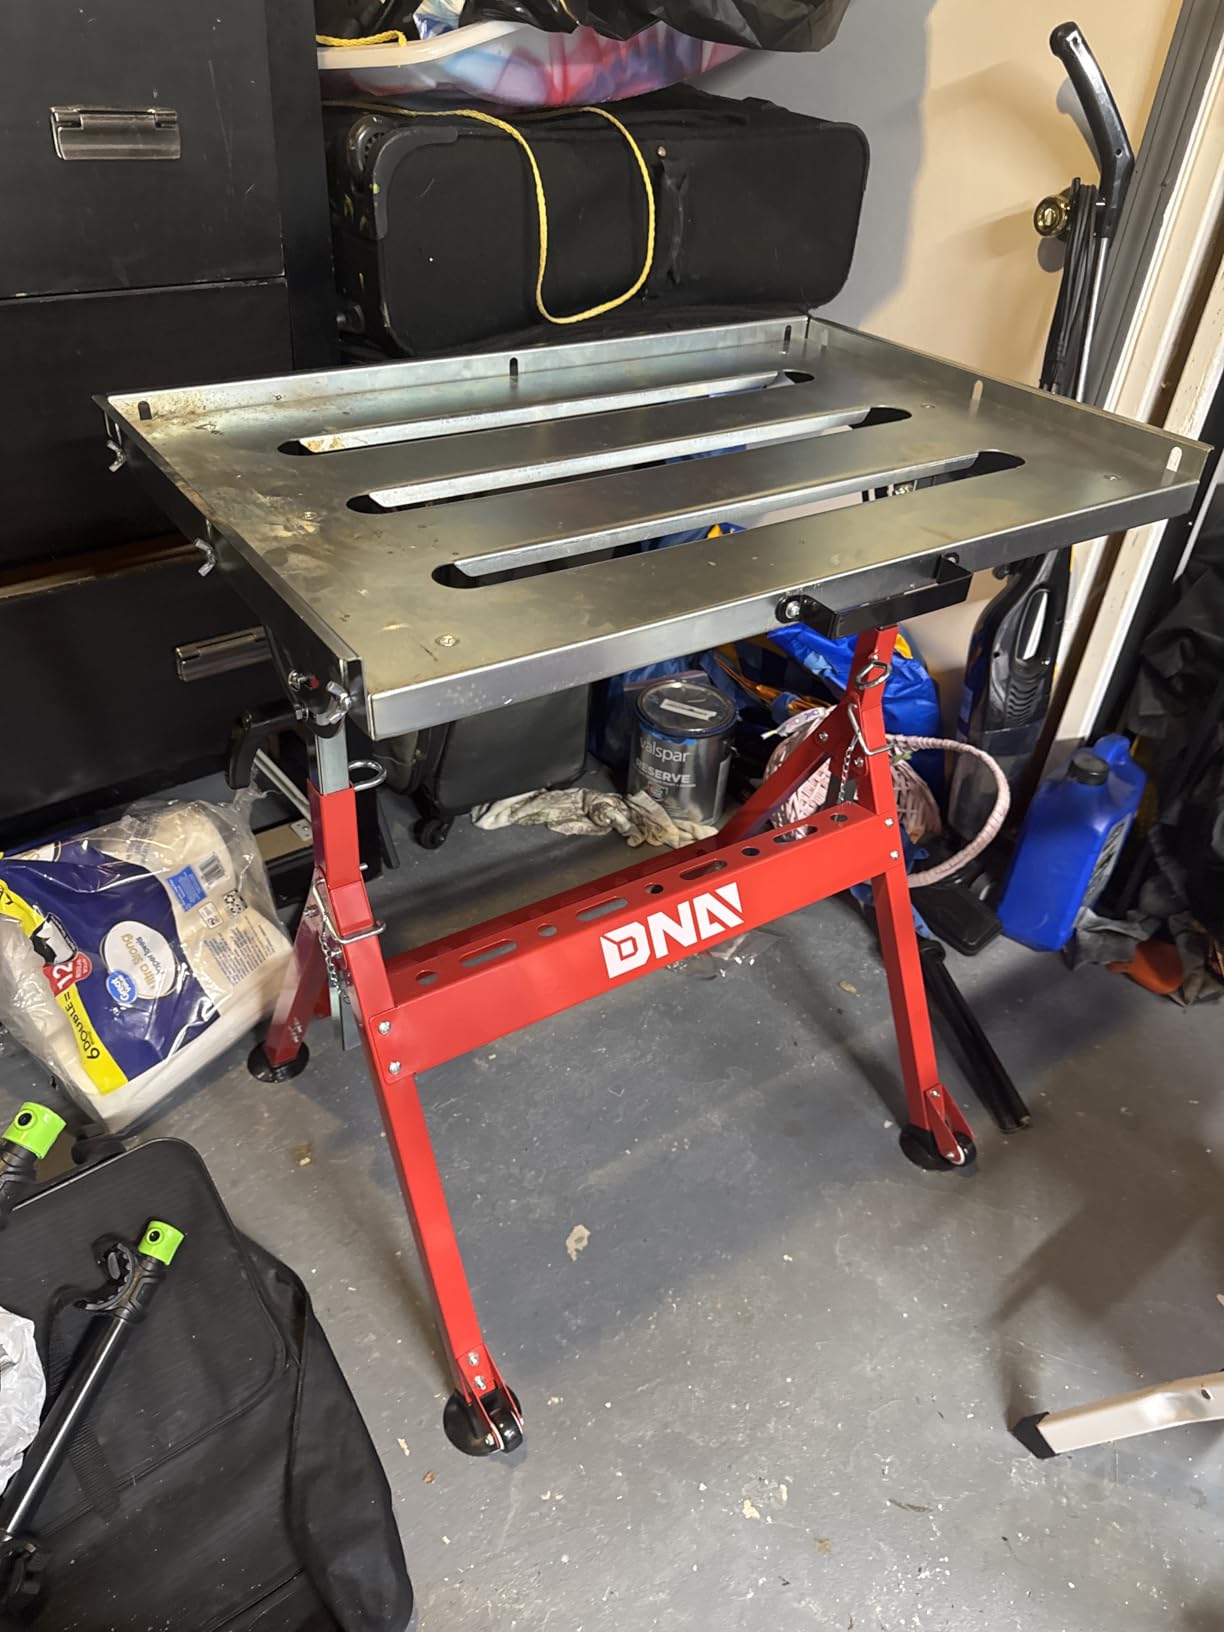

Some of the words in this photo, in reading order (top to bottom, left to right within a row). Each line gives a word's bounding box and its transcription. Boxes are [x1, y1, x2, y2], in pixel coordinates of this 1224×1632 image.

[640, 738, 690, 763] valspar
[600, 881, 745, 980] DNA
[121, 933, 144, 965] Strong
[52, 961, 73, 990] 12
[65, 1002, 91, 1053] DOUBLE
[86, 1047, 100, 1060] 6
